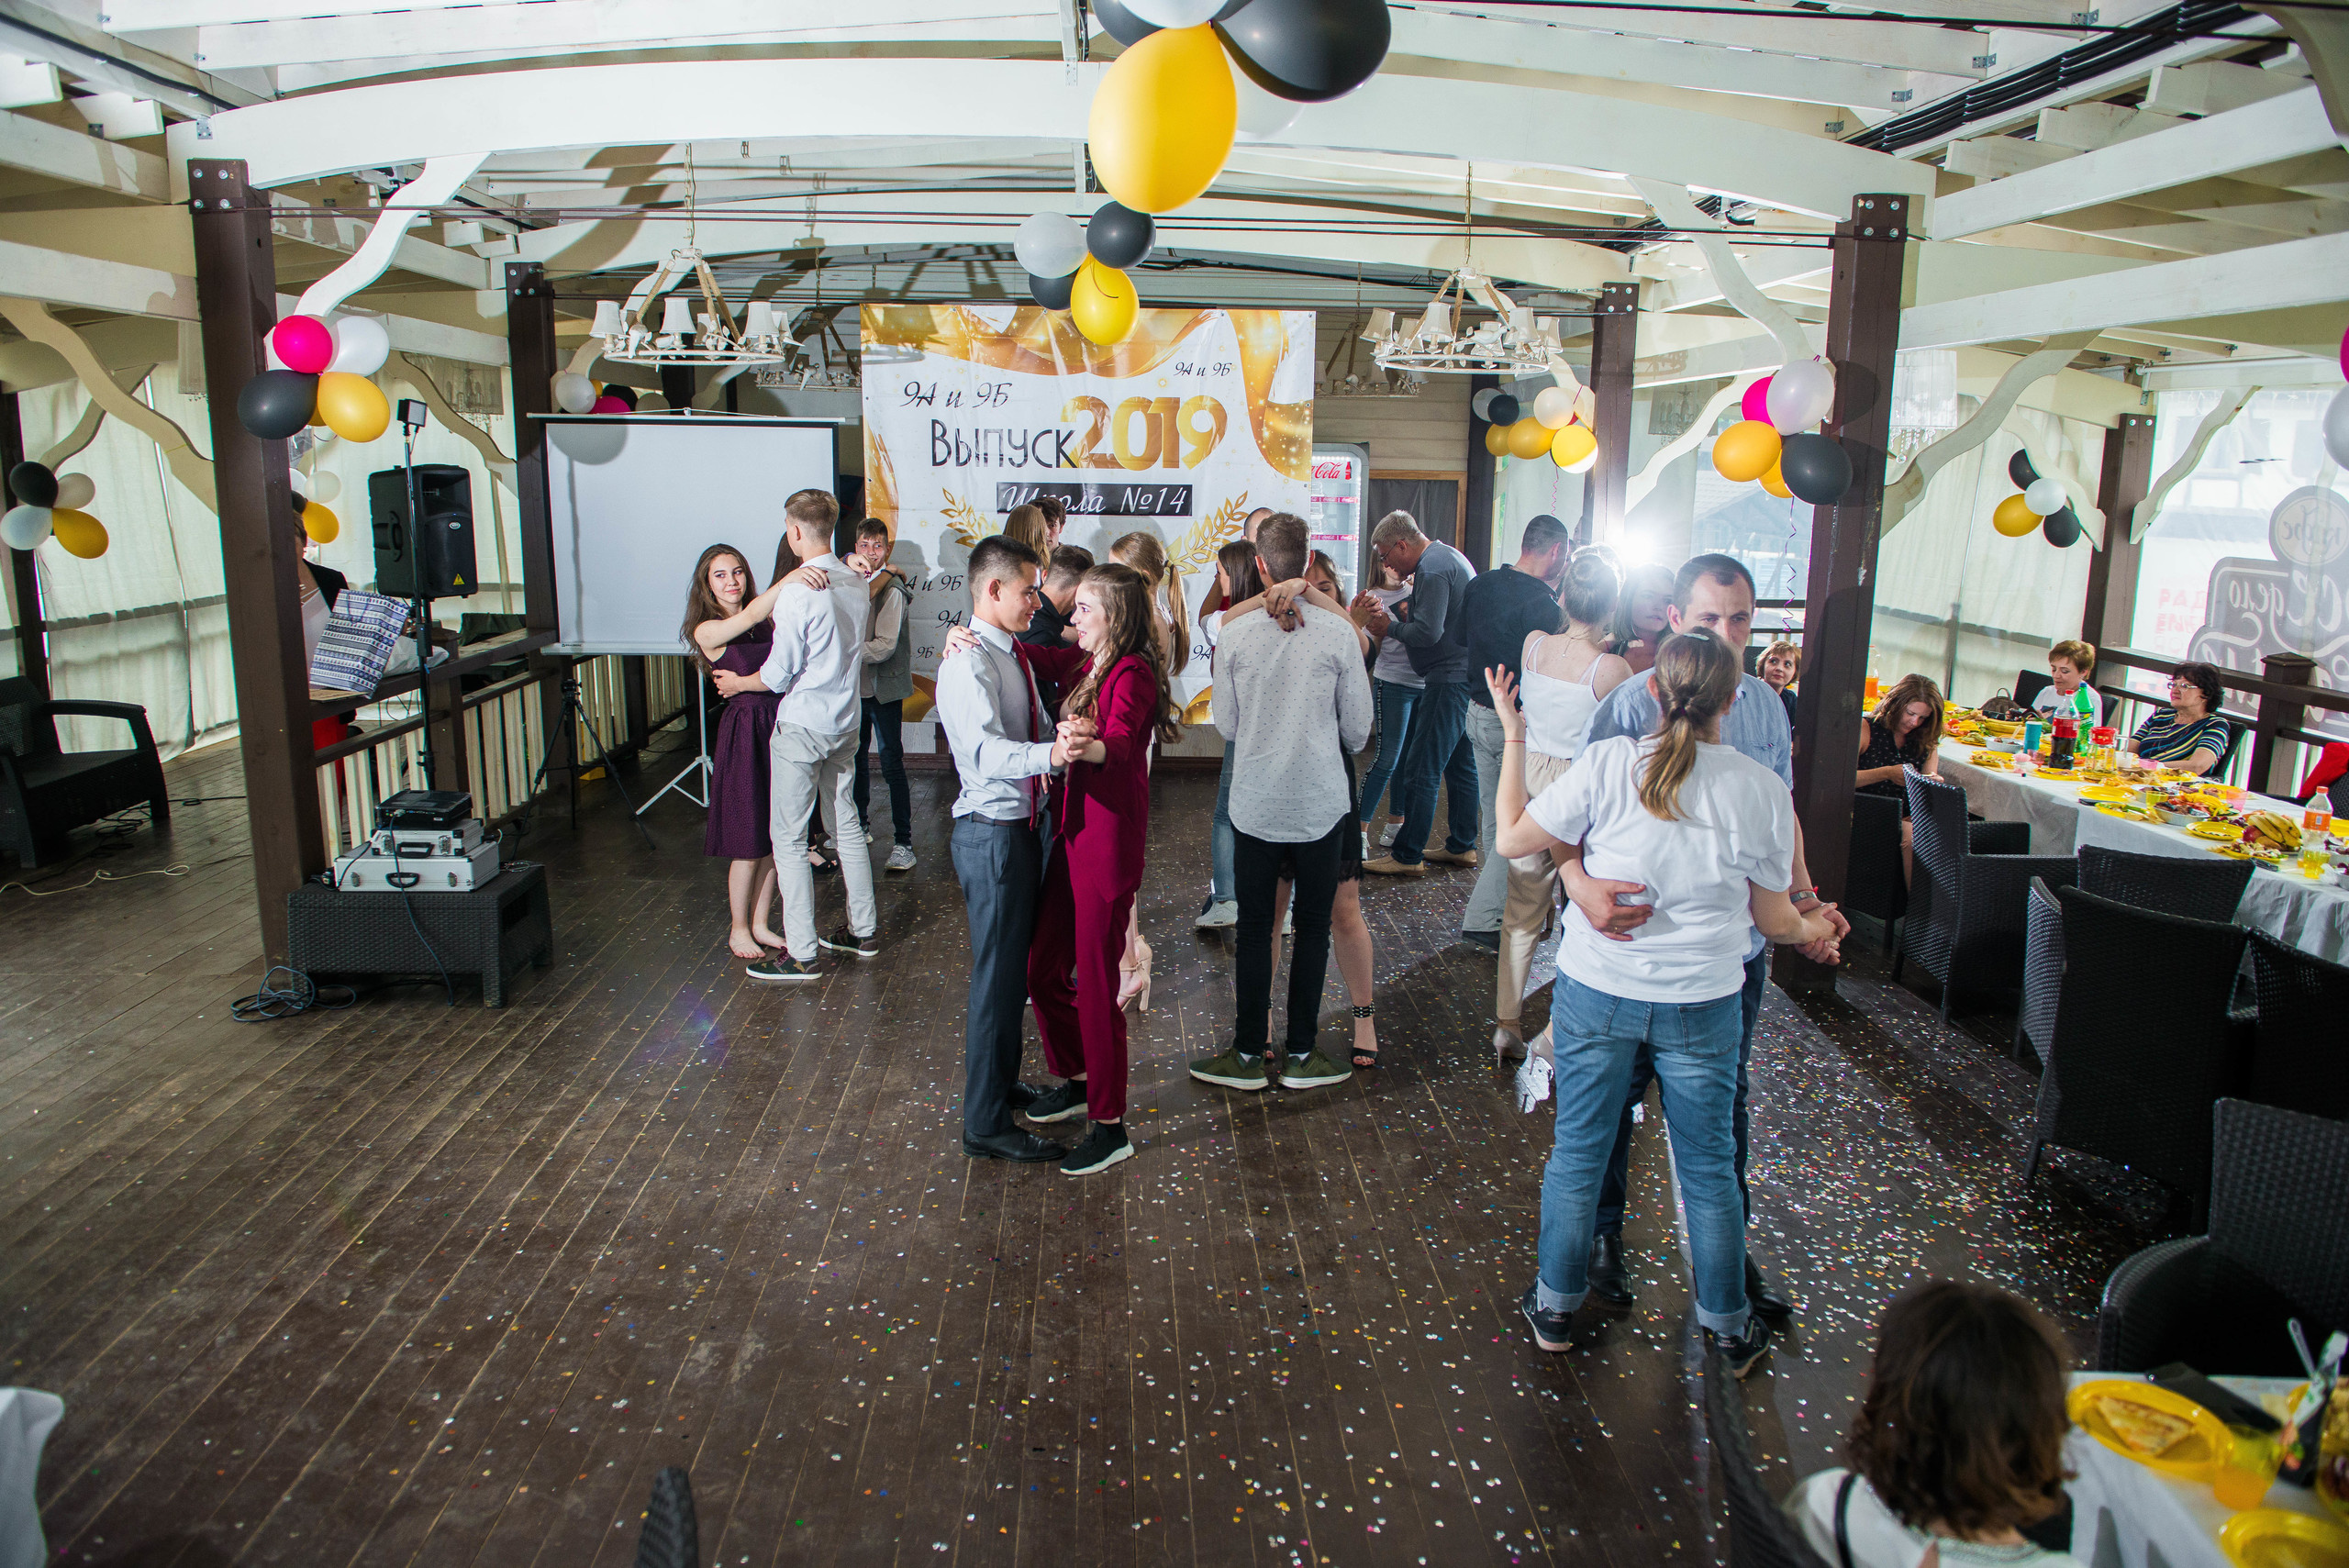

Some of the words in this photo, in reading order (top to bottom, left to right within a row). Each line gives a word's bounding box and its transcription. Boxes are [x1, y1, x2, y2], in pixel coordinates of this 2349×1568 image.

[1174, 361, 1193, 376] 9А
[1197, 367, 1207, 377] и
[1211, 361, 1232, 377] 9Б
[899, 381, 938, 408] 9А
[946, 390, 962, 408] и
[972, 382, 1013, 408] 9Б
[1061, 395, 1228, 471] 2019
[921, 580, 934, 592] и
[939, 574, 963, 592] 9Б
[935, 609, 963, 628] 9А
[916, 646, 935, 659] 9Б
[1191, 644, 1212, 661] 9А
